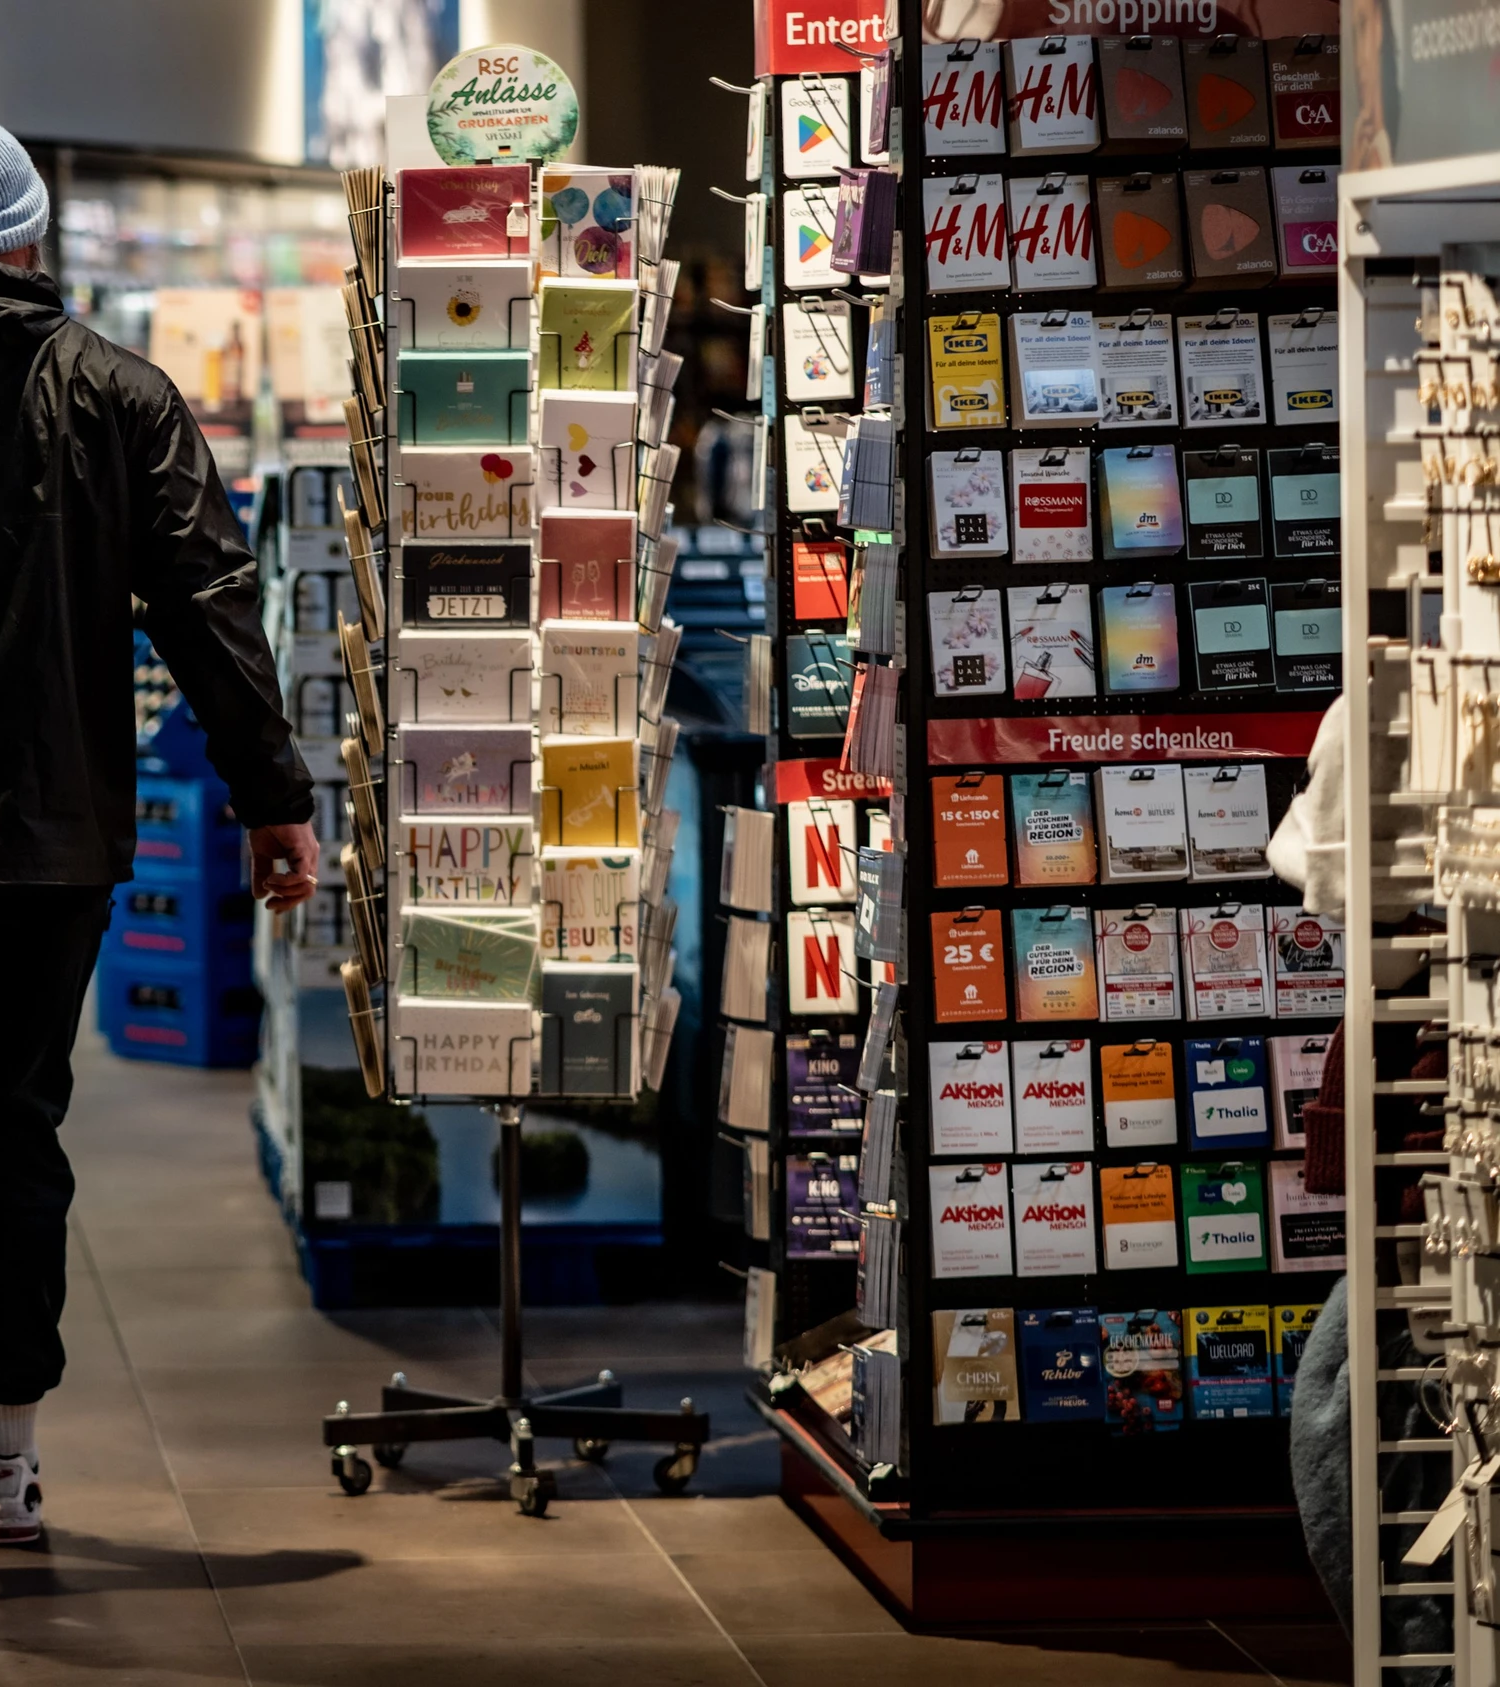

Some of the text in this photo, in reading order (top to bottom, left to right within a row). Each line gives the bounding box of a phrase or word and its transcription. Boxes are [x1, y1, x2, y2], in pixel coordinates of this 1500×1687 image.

[1048, 0, 1217, 32] Shopping
[478, 56, 519, 75] RSC
[1272, 63, 1288, 72] Ein
[1273, 71, 1320, 82] Geschenk
[447, 76, 557, 109] Anlässe
[1274, 81, 1313, 92] für dich!
[1012, 62, 1097, 124] H&M
[789, 97, 821, 109] Google
[923, 70, 1002, 131] H&M
[1295, 103, 1333, 125] C&A
[1148, 126, 1184, 136] zalando
[1230, 134, 1266, 143] zalando
[924, 203, 1006, 266] H&M
[1010, 203, 1094, 264] H&M
[1302, 232, 1338, 253] C&A
[1236, 260, 1273, 271] zalando
[1146, 269, 1183, 280] zalando
[947, 338, 984, 349] IKEA
[1209, 338, 1230, 346] deine
[948, 359, 956, 367] all
[958, 359, 976, 367] deine
[977, 358, 999, 366] Ideen!
[1046, 386, 1077, 396] IKEA
[1208, 393, 1239, 401] IKEA
[953, 397, 986, 408] IKEA
[1121, 394, 1151, 402] IKEA
[1291, 395, 1329, 405] IKEA
[415, 491, 454, 502] YOUR
[1024, 496, 1083, 507] ROSSMANN
[402, 491, 531, 533] Birthday
[1139, 512, 1157, 524] dm
[1227, 541, 1246, 550] Dich
[1315, 538, 1334, 547] Dich
[436, 596, 493, 616] JETZT
[1026, 635, 1074, 645] ROSSMANN
[553, 645, 626, 657] GEBURTSTAG
[1135, 653, 1154, 666] dm
[1238, 671, 1258, 680] Dich
[1315, 673, 1334, 682] Dich
[1049, 726, 1234, 751] Freude schenken
[579, 760, 610, 773] Musik!
[1027, 816, 1069, 824] GUTSCHEIN
[1029, 829, 1074, 840] REGION
[409, 826, 524, 869] HAPPY
[805, 824, 841, 889] N
[409, 874, 521, 902] BIRTHDAY
[541, 926, 634, 949] GEBURTS
[943, 944, 974, 963] 25
[1029, 949, 1071, 959] GUTSCHEIN
[1053, 955, 1074, 963] DEINE
[804, 935, 841, 1000] N
[1030, 963, 1075, 976] REGION
[423, 1034, 501, 1050] HAPPY
[404, 1054, 519, 1073] BIRTHDAY
[808, 1059, 840, 1076] KINO
[967, 1100, 1004, 1109] MENSCH
[1049, 1099, 1086, 1108] MENSCH
[1216, 1106, 1258, 1119] Thalia
[808, 1178, 840, 1198] KINO
[968, 1222, 1004, 1232] MENSCH
[1049, 1222, 1087, 1231] MENSCH
[1212, 1231, 1255, 1245] Thalia
[1209, 1342, 1255, 1361] WELLCARD
[957, 1370, 1001, 1385] CHRIST
[1042, 1368, 1084, 1380] Tchibo
